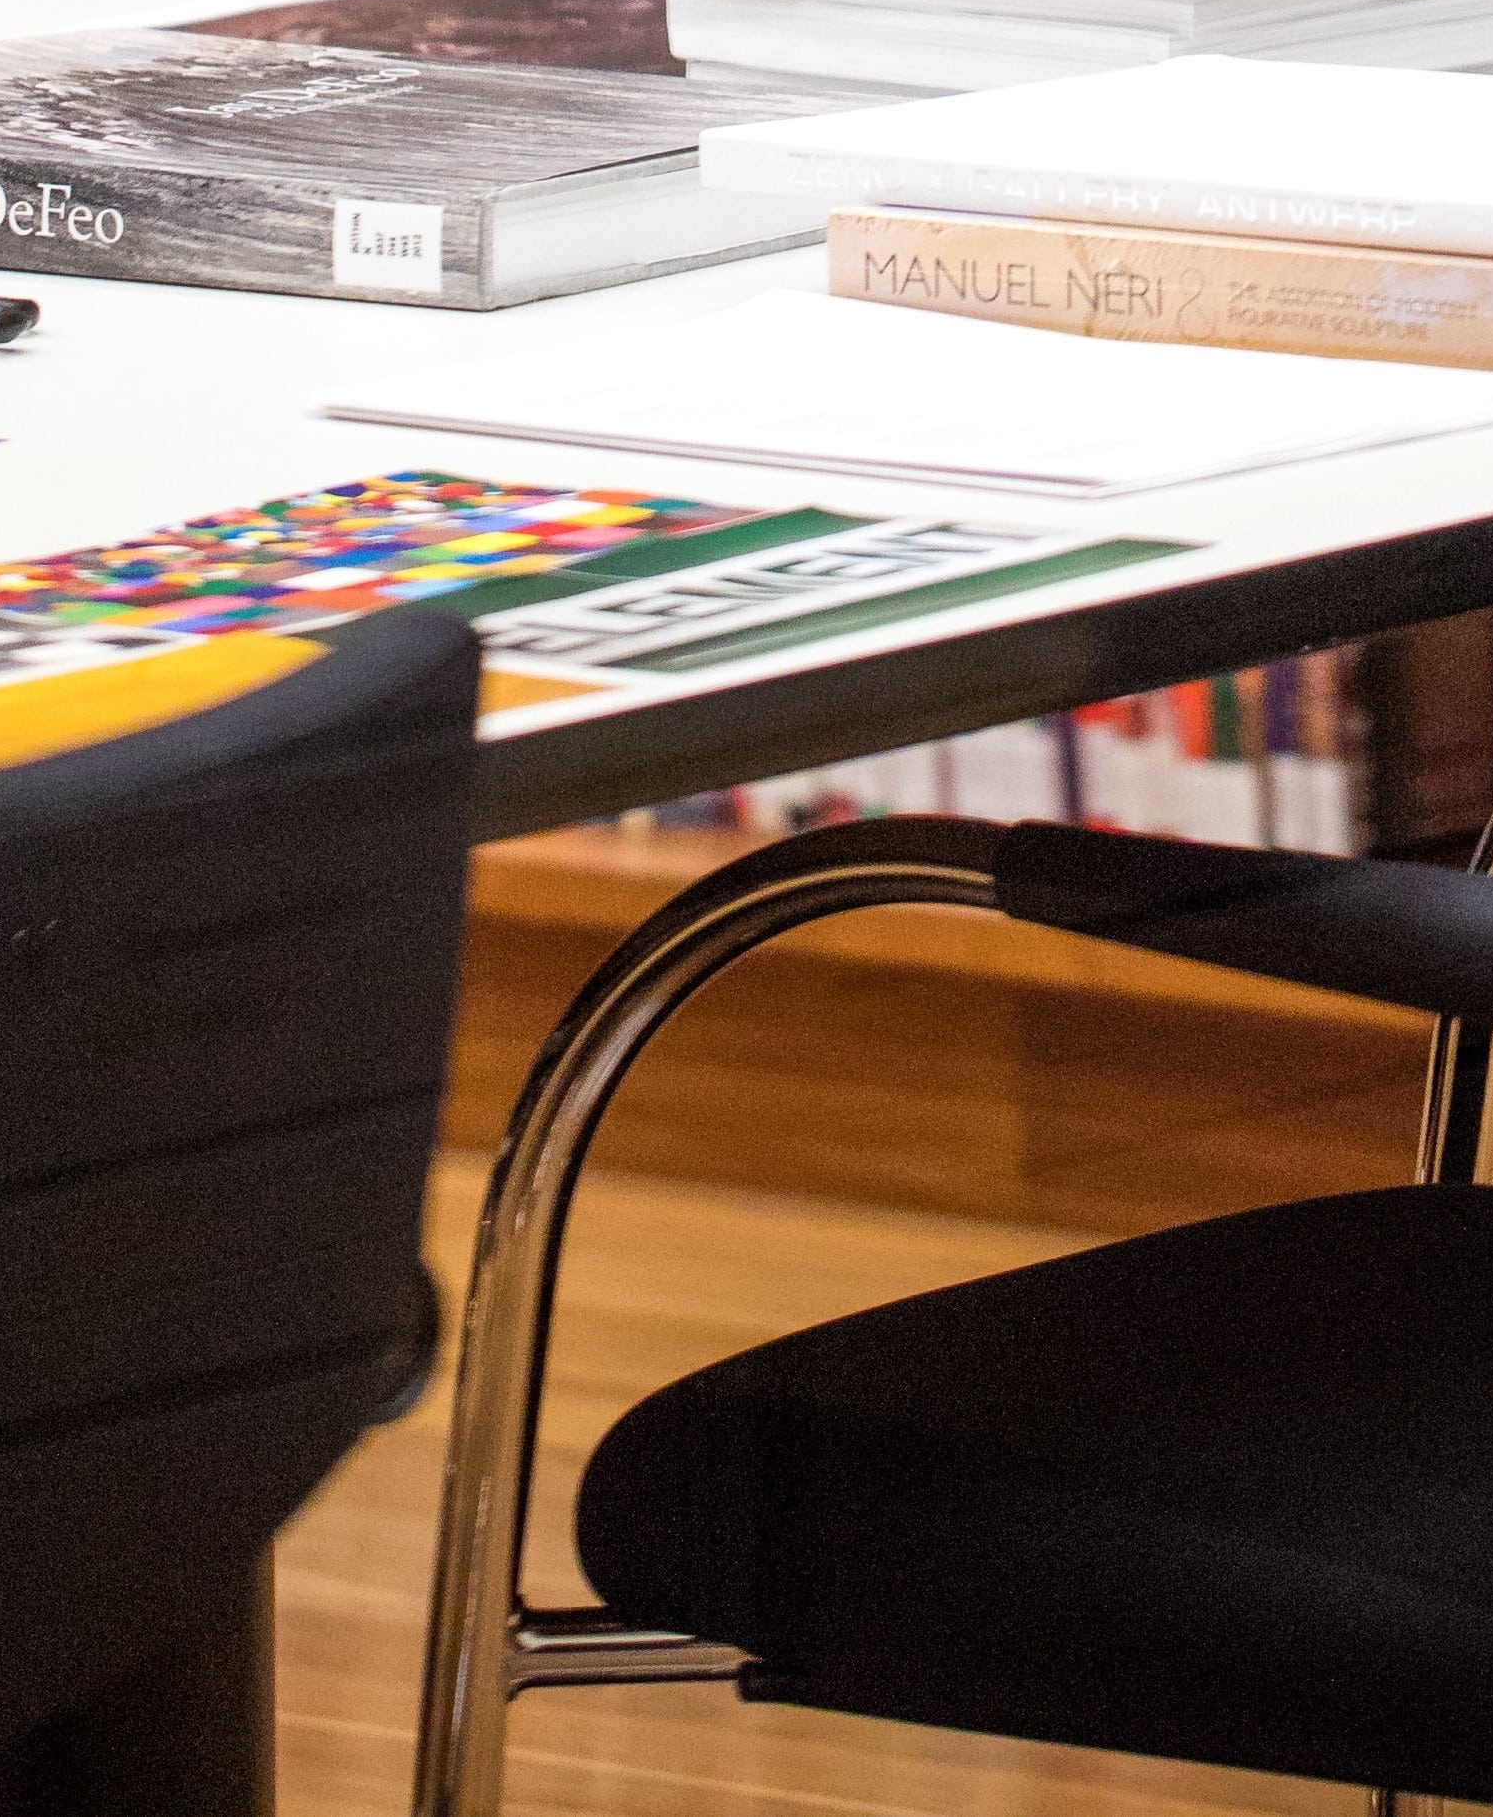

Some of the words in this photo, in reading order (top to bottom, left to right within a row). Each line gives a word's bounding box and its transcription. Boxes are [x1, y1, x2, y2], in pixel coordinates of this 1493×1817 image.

[363, 246, 371, 255] N
[411, 233, 422, 258] 2012
[863, 250, 1052, 309] MANUEL
[1066, 268, 1164, 318] NERI
